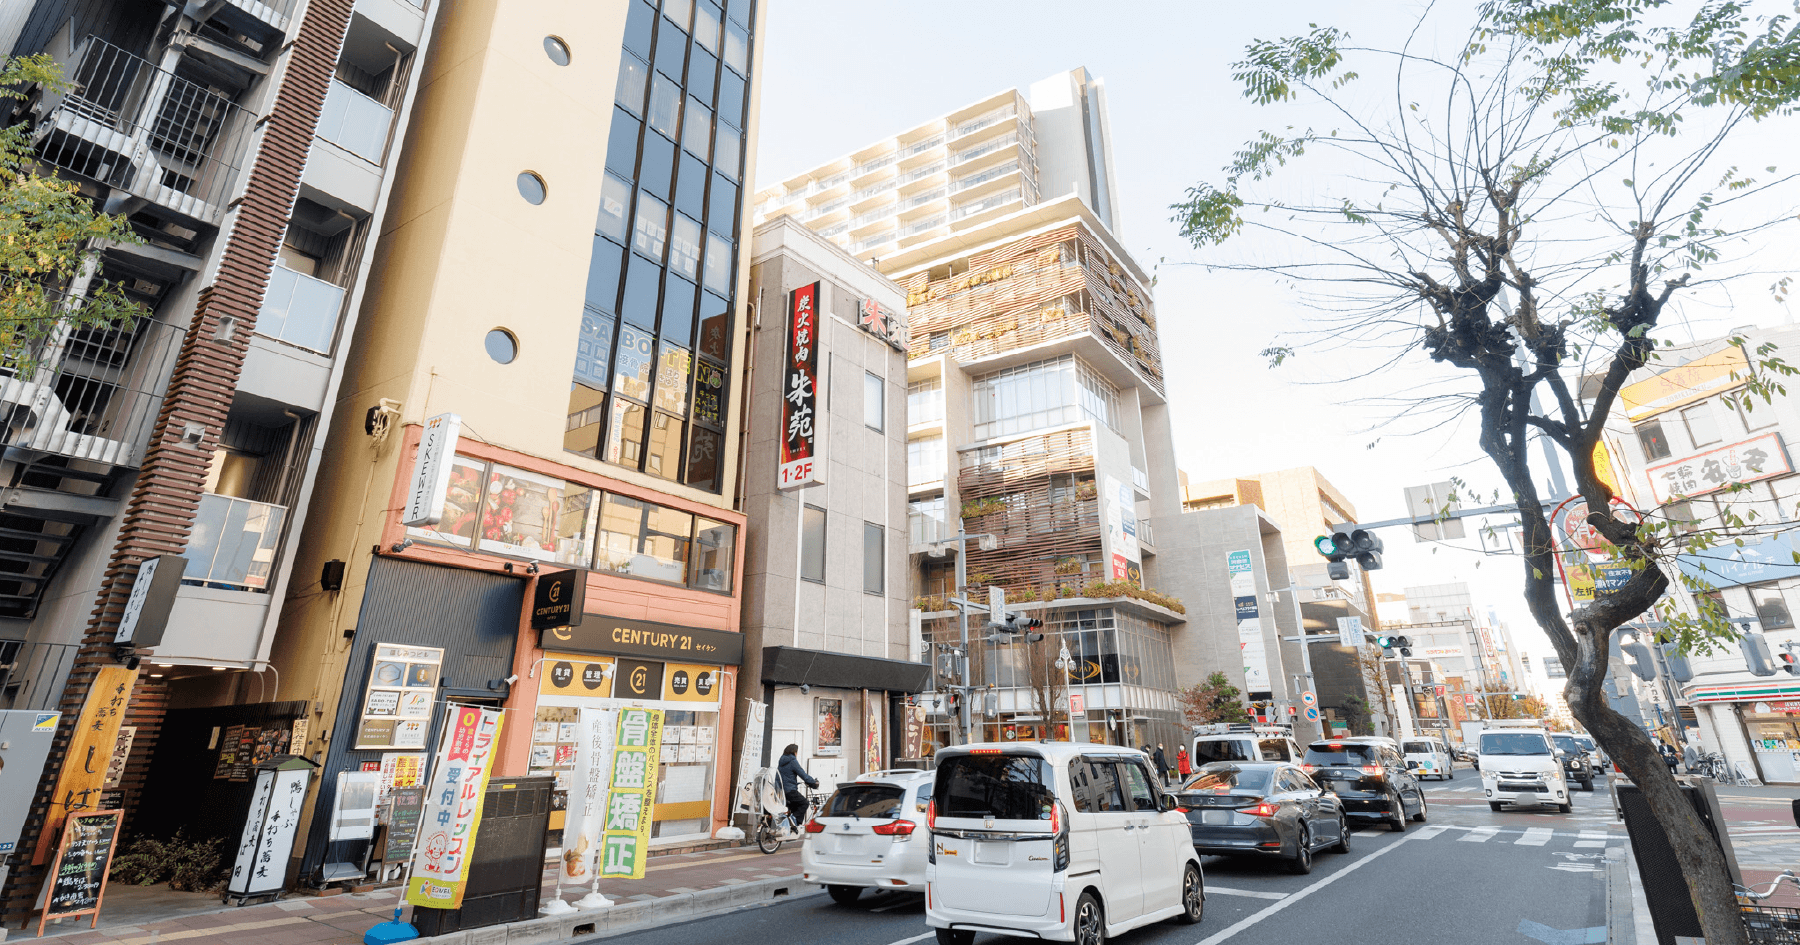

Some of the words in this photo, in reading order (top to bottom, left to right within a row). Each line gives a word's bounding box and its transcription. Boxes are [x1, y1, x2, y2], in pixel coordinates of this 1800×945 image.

[793, 294, 811, 362] 炭火焼肉
[785, 369, 814, 443] 朱苑
[411, 433, 434, 520] SKEWER
[1661, 464, 1693, 480] 七輪
[1668, 479, 1697, 496] 焼肉
[1701, 447, 1769, 484] 安安
[536, 605, 563, 616] CENTURY
[563, 603, 570, 613] 21
[1573, 586, 1595, 597] 左折
[612, 627, 679, 649] CENTURY
[680, 635, 692, 650] 21
[695, 643, 717, 652] セイケン
[582, 720, 602, 817] 産後骨盤矯正
[604, 710, 648, 874] 骨盤矯正
[437, 766, 462, 827] 受付中
[444, 716, 495, 874] トライアルレッスン
[256, 810, 281, 879] 手打ち蕎麦
[937, 843, 943, 851] N
